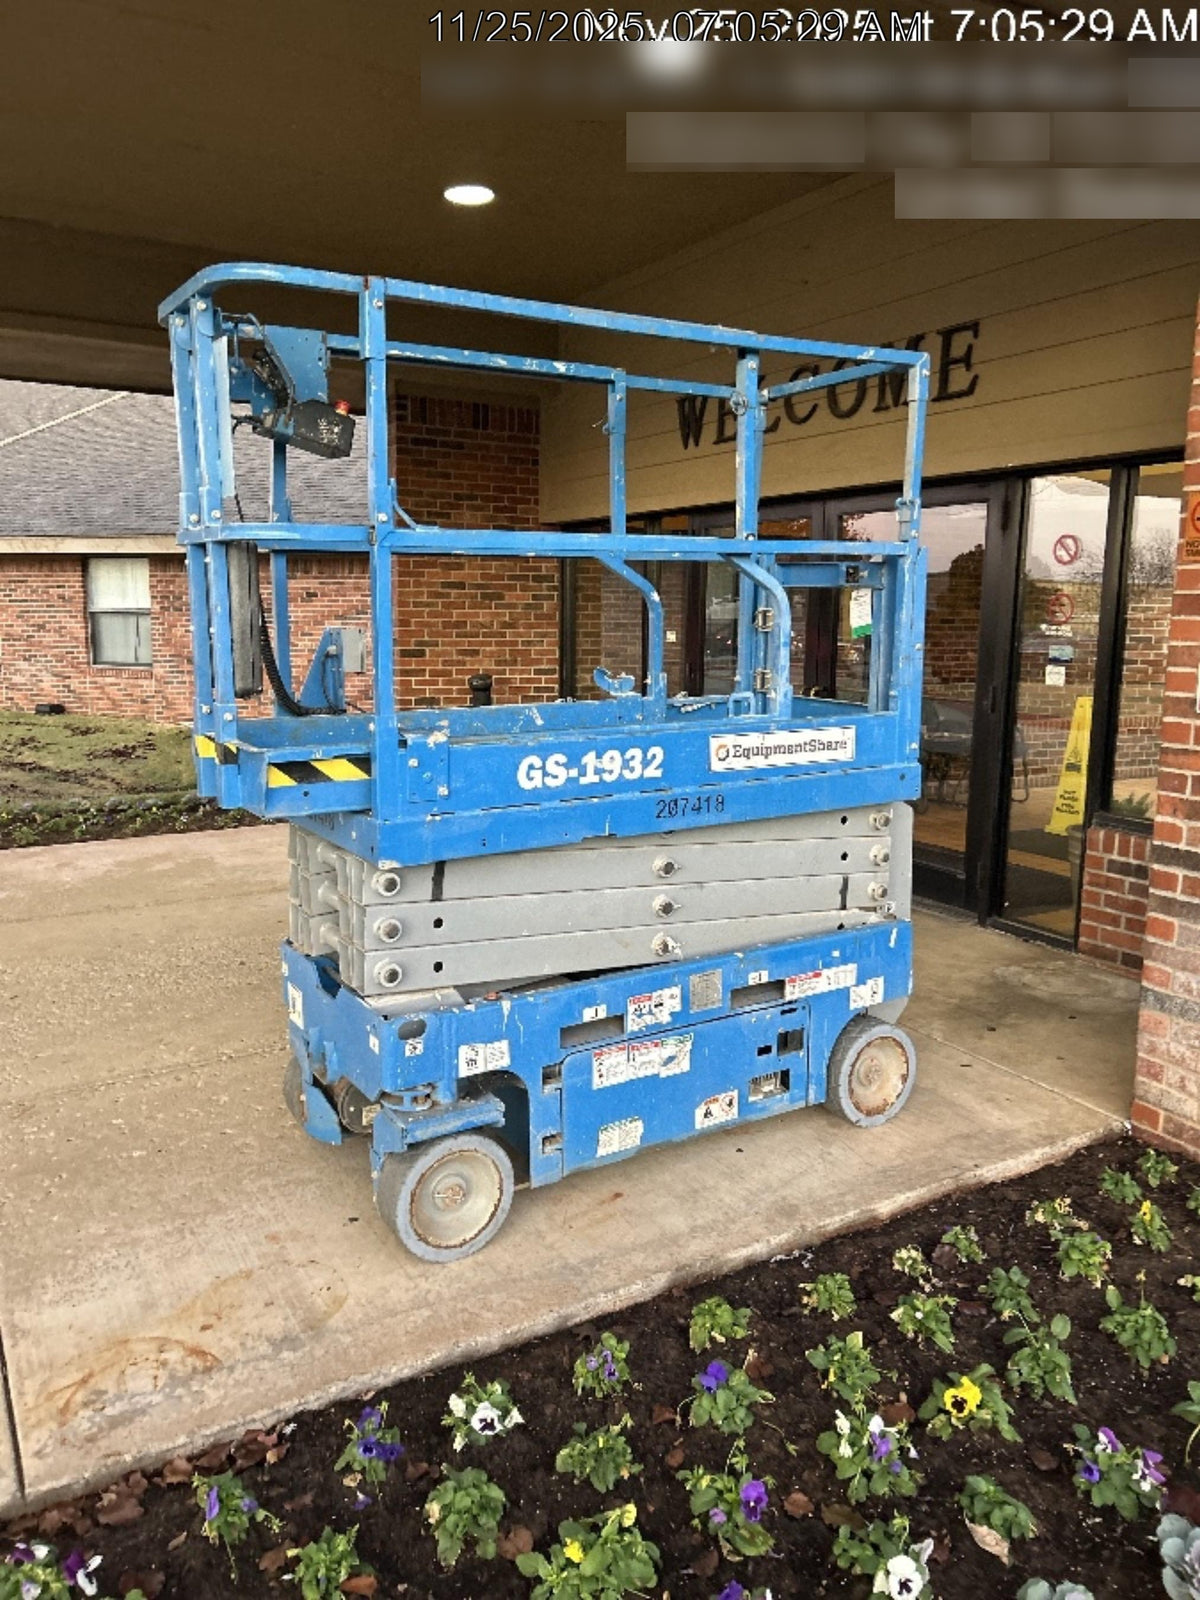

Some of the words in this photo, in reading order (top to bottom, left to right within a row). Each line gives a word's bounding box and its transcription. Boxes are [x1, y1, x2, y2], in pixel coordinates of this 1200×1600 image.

[732, 739, 848, 760] EquipmentShare
[517, 746, 665, 791] GS-1932
[656, 794, 725, 818] 207418
